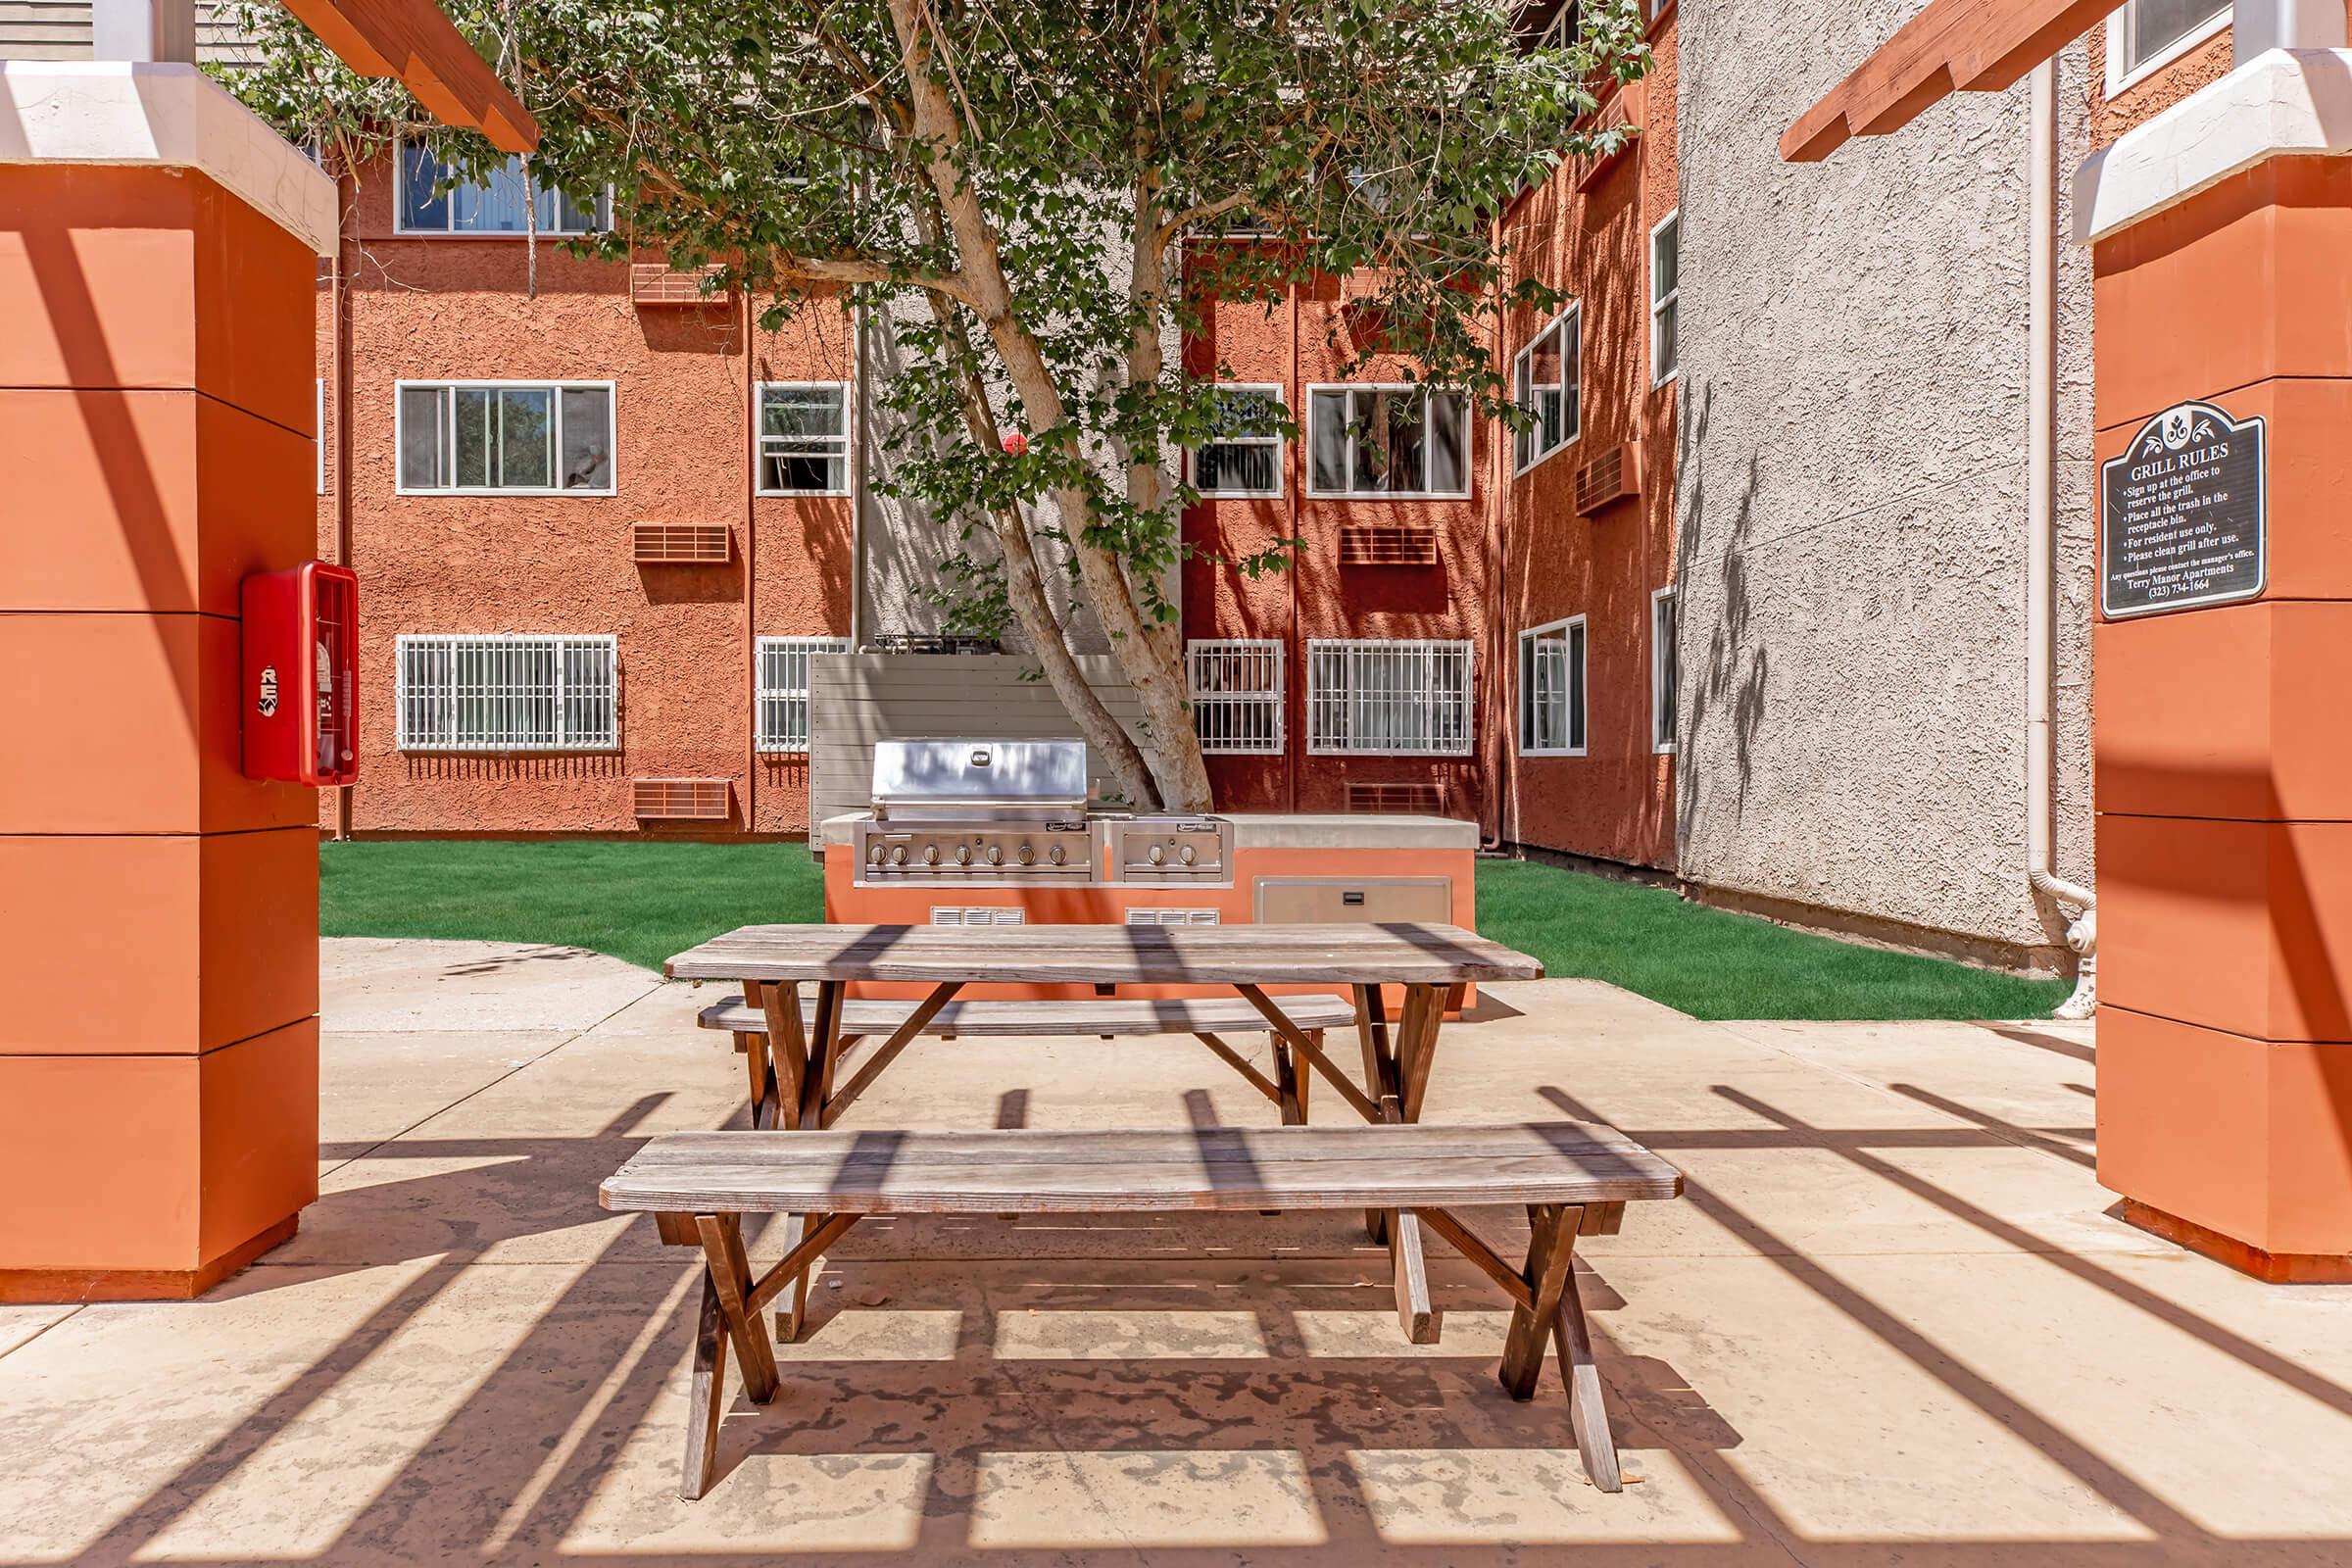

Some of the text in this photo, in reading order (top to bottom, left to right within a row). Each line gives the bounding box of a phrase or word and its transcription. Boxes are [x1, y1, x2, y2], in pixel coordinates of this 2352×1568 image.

[2131, 442, 2229, 481] GRILL RULES
[2128, 466, 2220, 497] Sign up at the office to
[2128, 484, 2193, 510] reserve the grill.
[2128, 492, 2228, 522] Place all the trash in the
[2128, 514, 2186, 534] receptacle bin.
[2129, 521, 2217, 549] For resident use only.
[2129, 533, 2239, 563] Please clean grill after use.
[2123, 568, 2148, 580] questions
[2149, 564, 2167, 575] please
[2168, 561, 2189, 570] contact
[2201, 553, 2233, 564] manager's
[2234, 550, 2254, 559] office.
[2127, 564, 2234, 589] Terry Manor Apartments
[2148, 579, 2209, 599] (323) 734-1664
